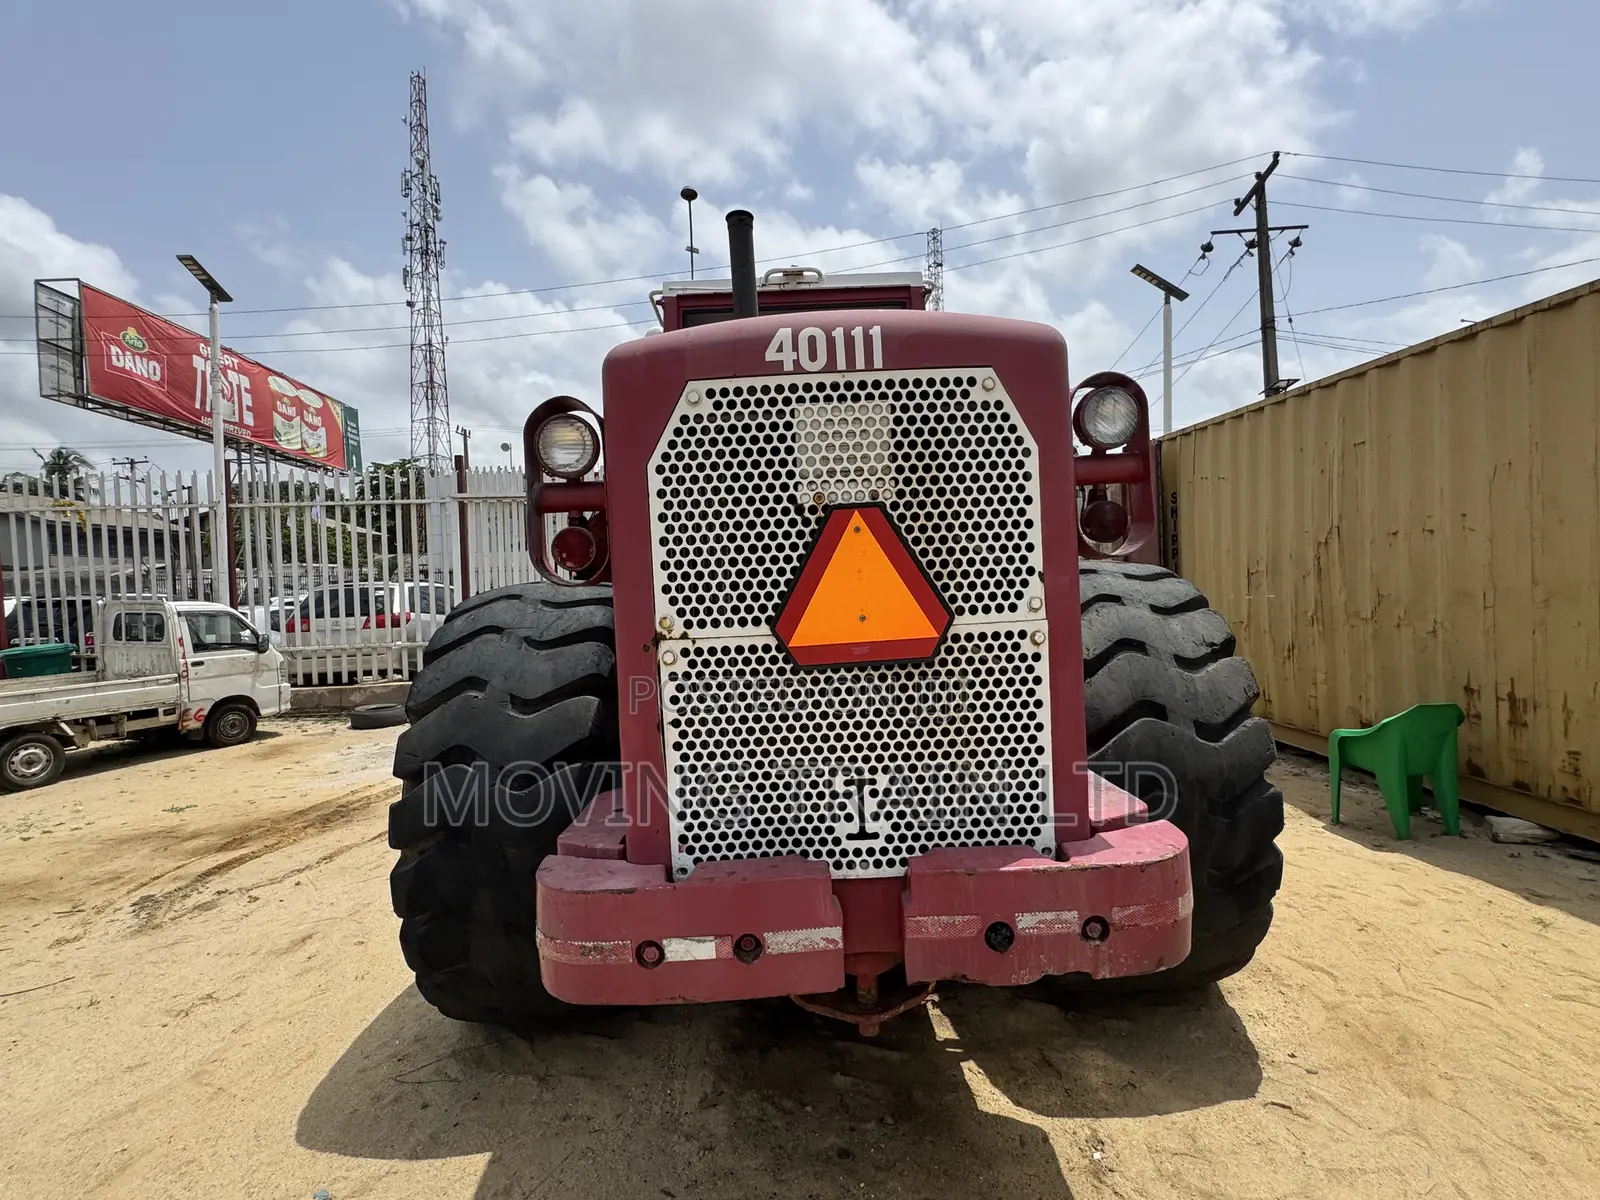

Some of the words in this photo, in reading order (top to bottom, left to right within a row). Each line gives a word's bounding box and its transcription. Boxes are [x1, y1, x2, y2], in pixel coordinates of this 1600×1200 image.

[110, 344, 161, 382] DANO
[199, 343, 239, 370] GAT
[765, 325, 883, 372] 40111
[192, 354, 254, 427] TTE
[224, 423, 252, 438] RRIVED
